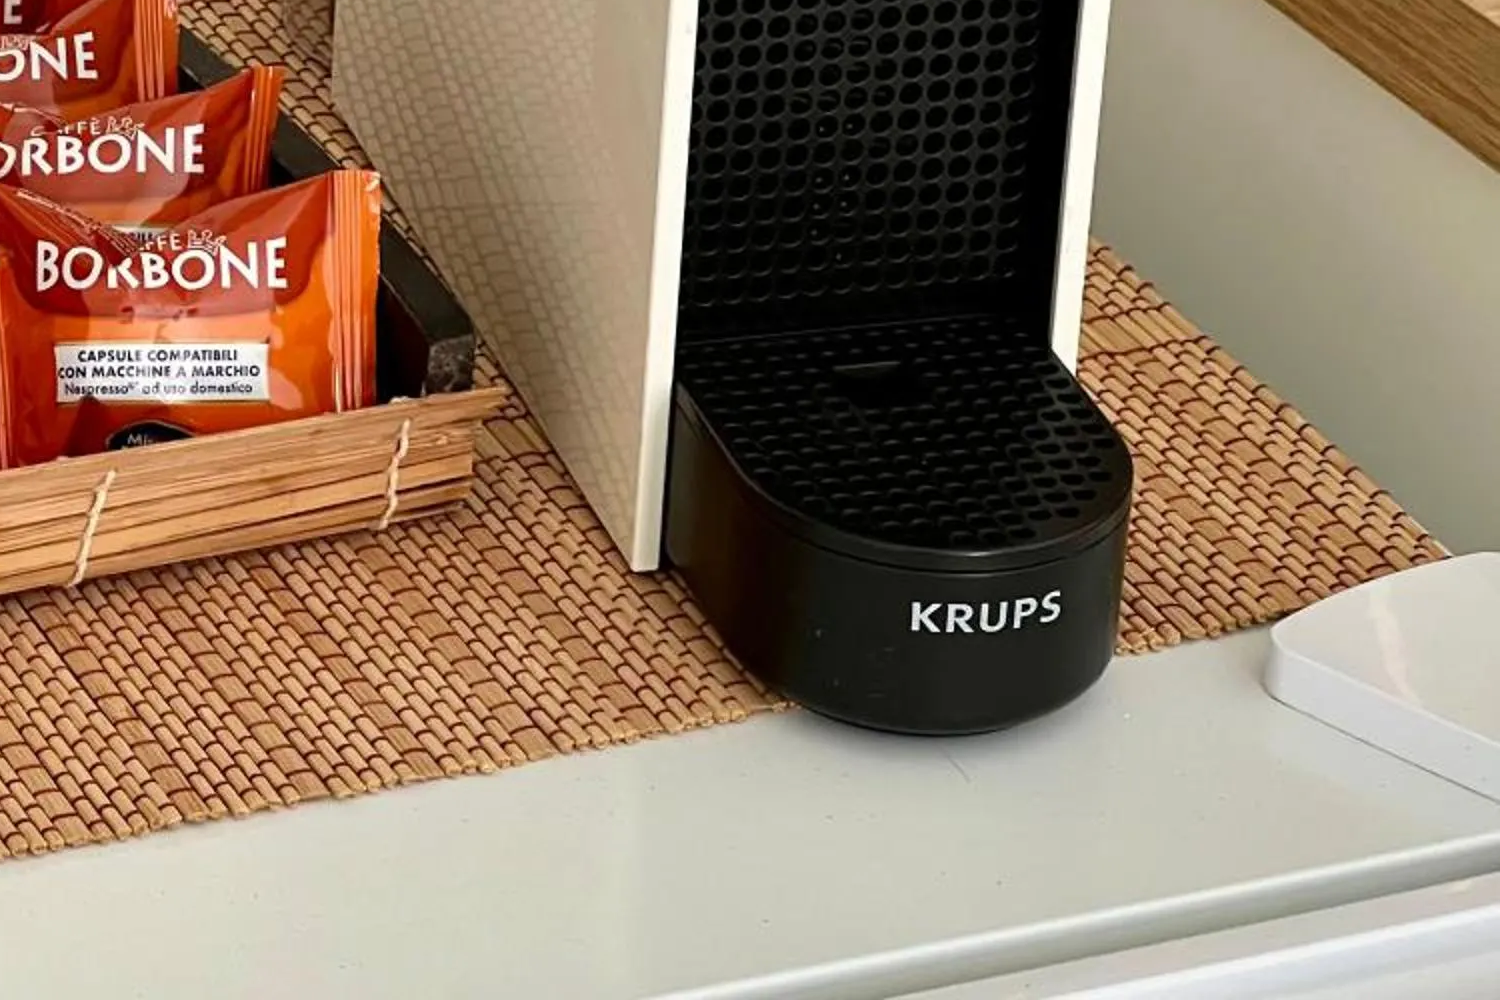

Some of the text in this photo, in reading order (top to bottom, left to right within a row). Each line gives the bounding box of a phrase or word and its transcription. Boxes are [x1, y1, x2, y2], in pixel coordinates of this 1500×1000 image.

[36, 238, 289, 292] BORBONE
[77, 350, 239, 362] CAPSULE COMPATIBILI
[57, 365, 261, 379] CON MACCHINE A MARCHIO
[142, 382, 161, 395] ad
[164, 384, 186, 395] uso
[190, 381, 254, 395] domestico
[910, 590, 1061, 633] KRUPS
